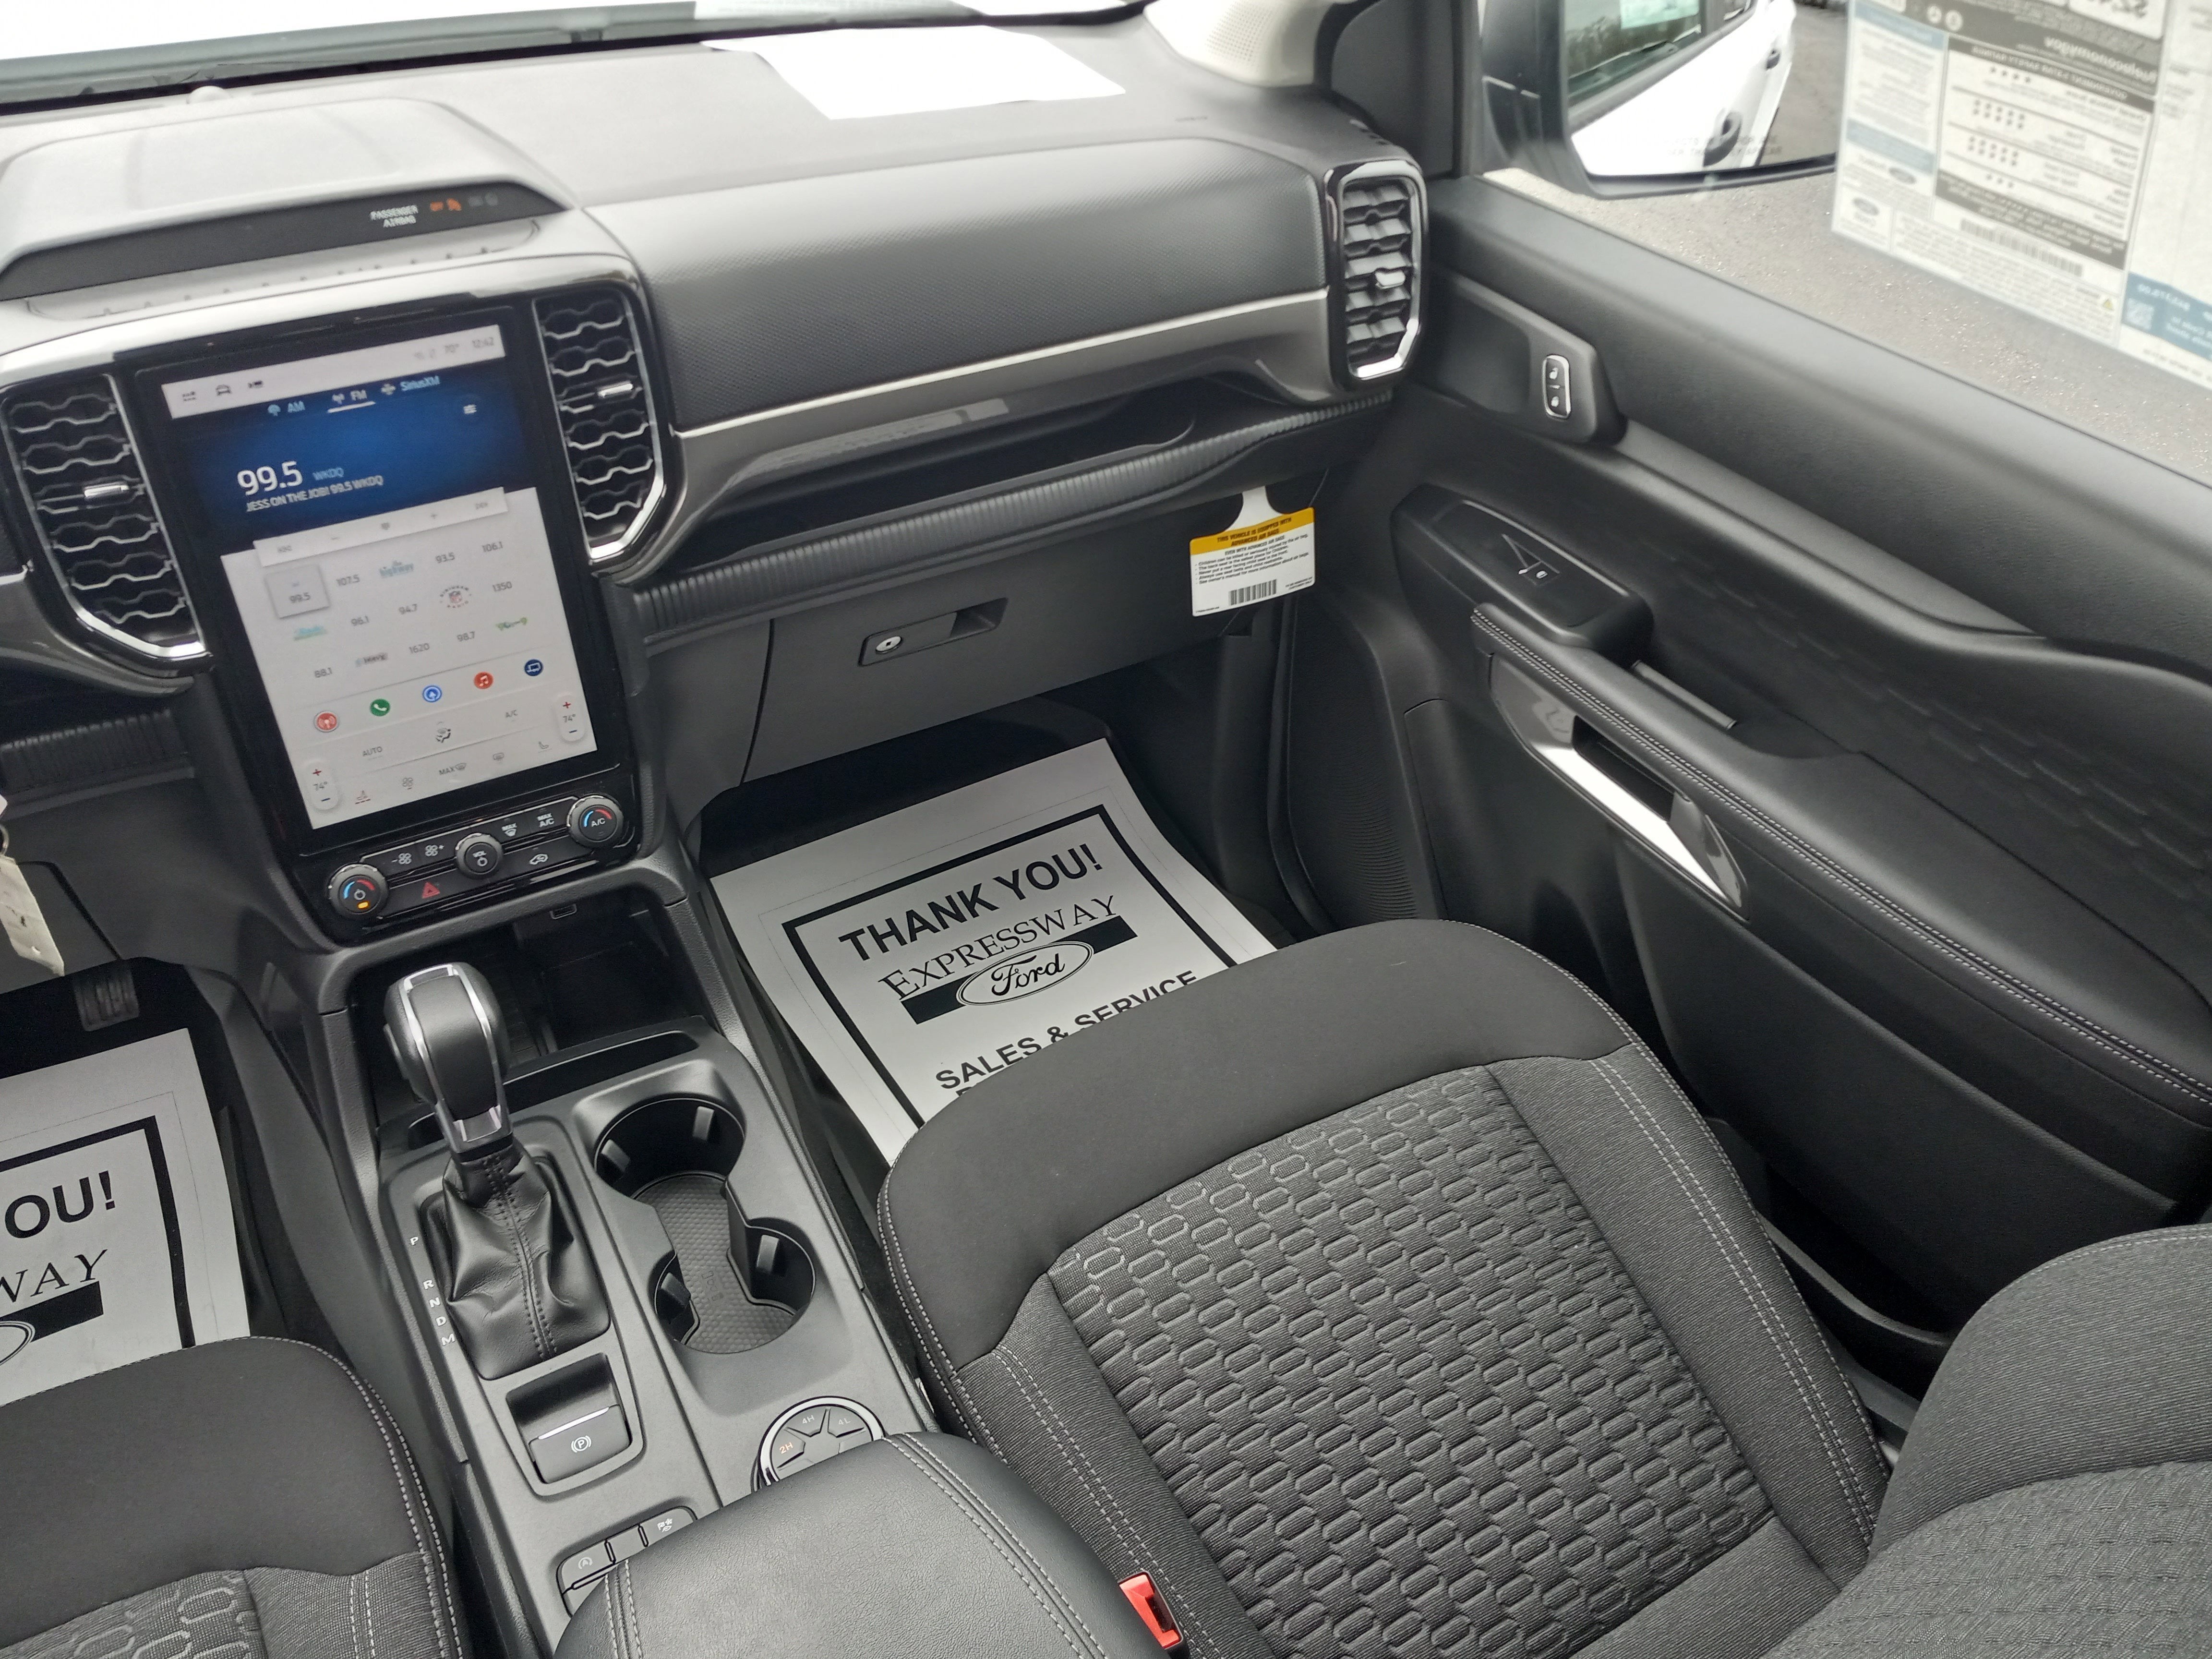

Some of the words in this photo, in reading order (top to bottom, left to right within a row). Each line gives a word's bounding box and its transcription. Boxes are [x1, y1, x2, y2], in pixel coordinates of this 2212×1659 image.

[370, 205, 418, 220] PASSENGER
[384, 215, 416, 228] AIRBAG
[400, 376, 440, 391] SiriusXM
[350, 389, 367, 401] FM
[288, 401, 305, 413] AM
[237, 460, 303, 496] 99.5
[313, 468, 345, 481] WKDQ
[246, 499, 271, 512] JESS
[270, 495, 287, 506] ON
[286, 490, 308, 503] THE
[329, 481, 353, 494] 99.5
[352, 474, 384, 489] WKDQ
[1230, 531, 1250, 540] VEHICLE
[1257, 522, 1278, 534] EQUIPPED
[1280, 517, 1291, 525] WITH
[1231, 536, 1257, 546] ADVANCED
[1267, 529, 1279, 537] BAGS
[482, 541, 504, 552] 106.1
[1247, 541, 1268, 551] ADVANCED
[435, 552, 455, 564] 93.5
[1259, 562, 1282, 570] information
[337, 574, 360, 586] 107.5
[493, 581, 513, 592] 1350
[289, 592, 311, 603] 99.5
[399, 604, 418, 615] 94.7
[351, 615, 370, 626] 96.1
[457, 631, 475, 642] 98.7
[409, 643, 430, 654] 1620
[505, 709, 518, 719] A/C
[362, 746, 383, 757] AUTO
[439, 767, 455, 776] MAX
[537, 812, 552, 821] MAX
[502, 822, 517, 832] MAX
[539, 817, 555, 828] A/C
[591, 817, 606, 828] A/C
[472, 850, 487, 858] VOL
[838, 882, 1000, 962] THANK
[992, 843, 1103, 901] YOU!
[878, 894, 1120, 1000] EXPRESSWAY
[991, 953, 1066, 996] Ford
[936, 1037, 1042, 1089] SALES
[1046, 1025, 1069, 1044] &
[4, 1170, 116, 1239] OU!
[410, 1236, 419, 1246] P
[423, 1279, 434, 1290] R
[429, 1297, 441, 1308] N
[436, 1316, 446, 1326] D
[441, 1333, 456, 1346] M
[802, 1415, 815, 1424] 4H
[779, 1442, 793, 1455] 2H
